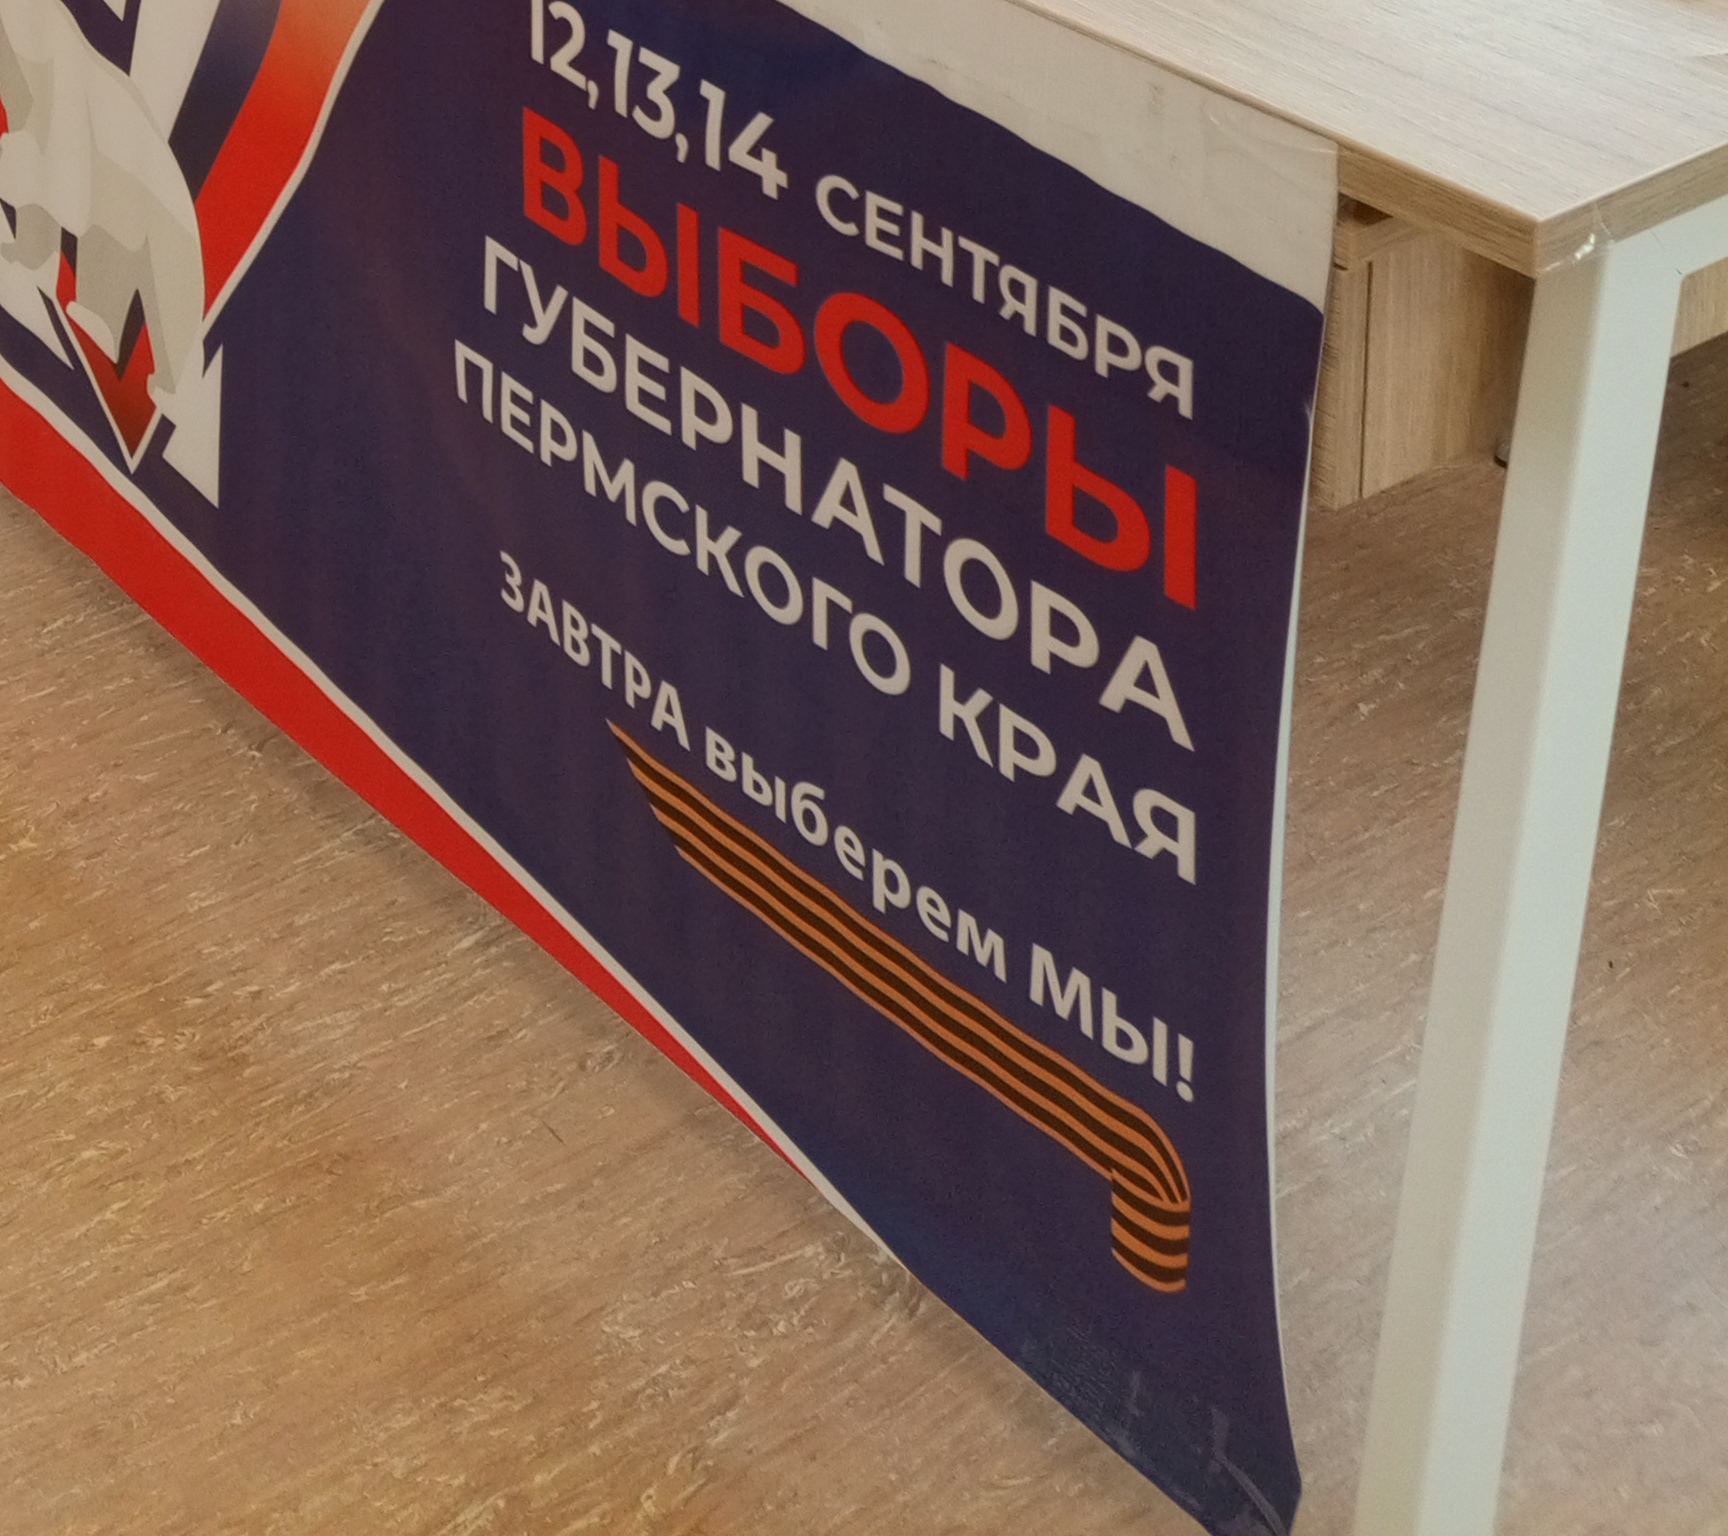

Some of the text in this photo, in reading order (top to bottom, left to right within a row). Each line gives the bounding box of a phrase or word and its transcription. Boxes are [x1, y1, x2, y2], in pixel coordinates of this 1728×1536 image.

[483, 235, 1196, 752] ГУБЕРНАТОРА
[522, 106, 1197, 611] ВЫБОРЫ
[815, 174, 1195, 420] СЕНТЯБРЯ
[454, 339, 1198, 886] ПЕРМСКОГО КРАЯ
[499, 550, 1196, 1103] ЗАВТРА выберем МЫ!
